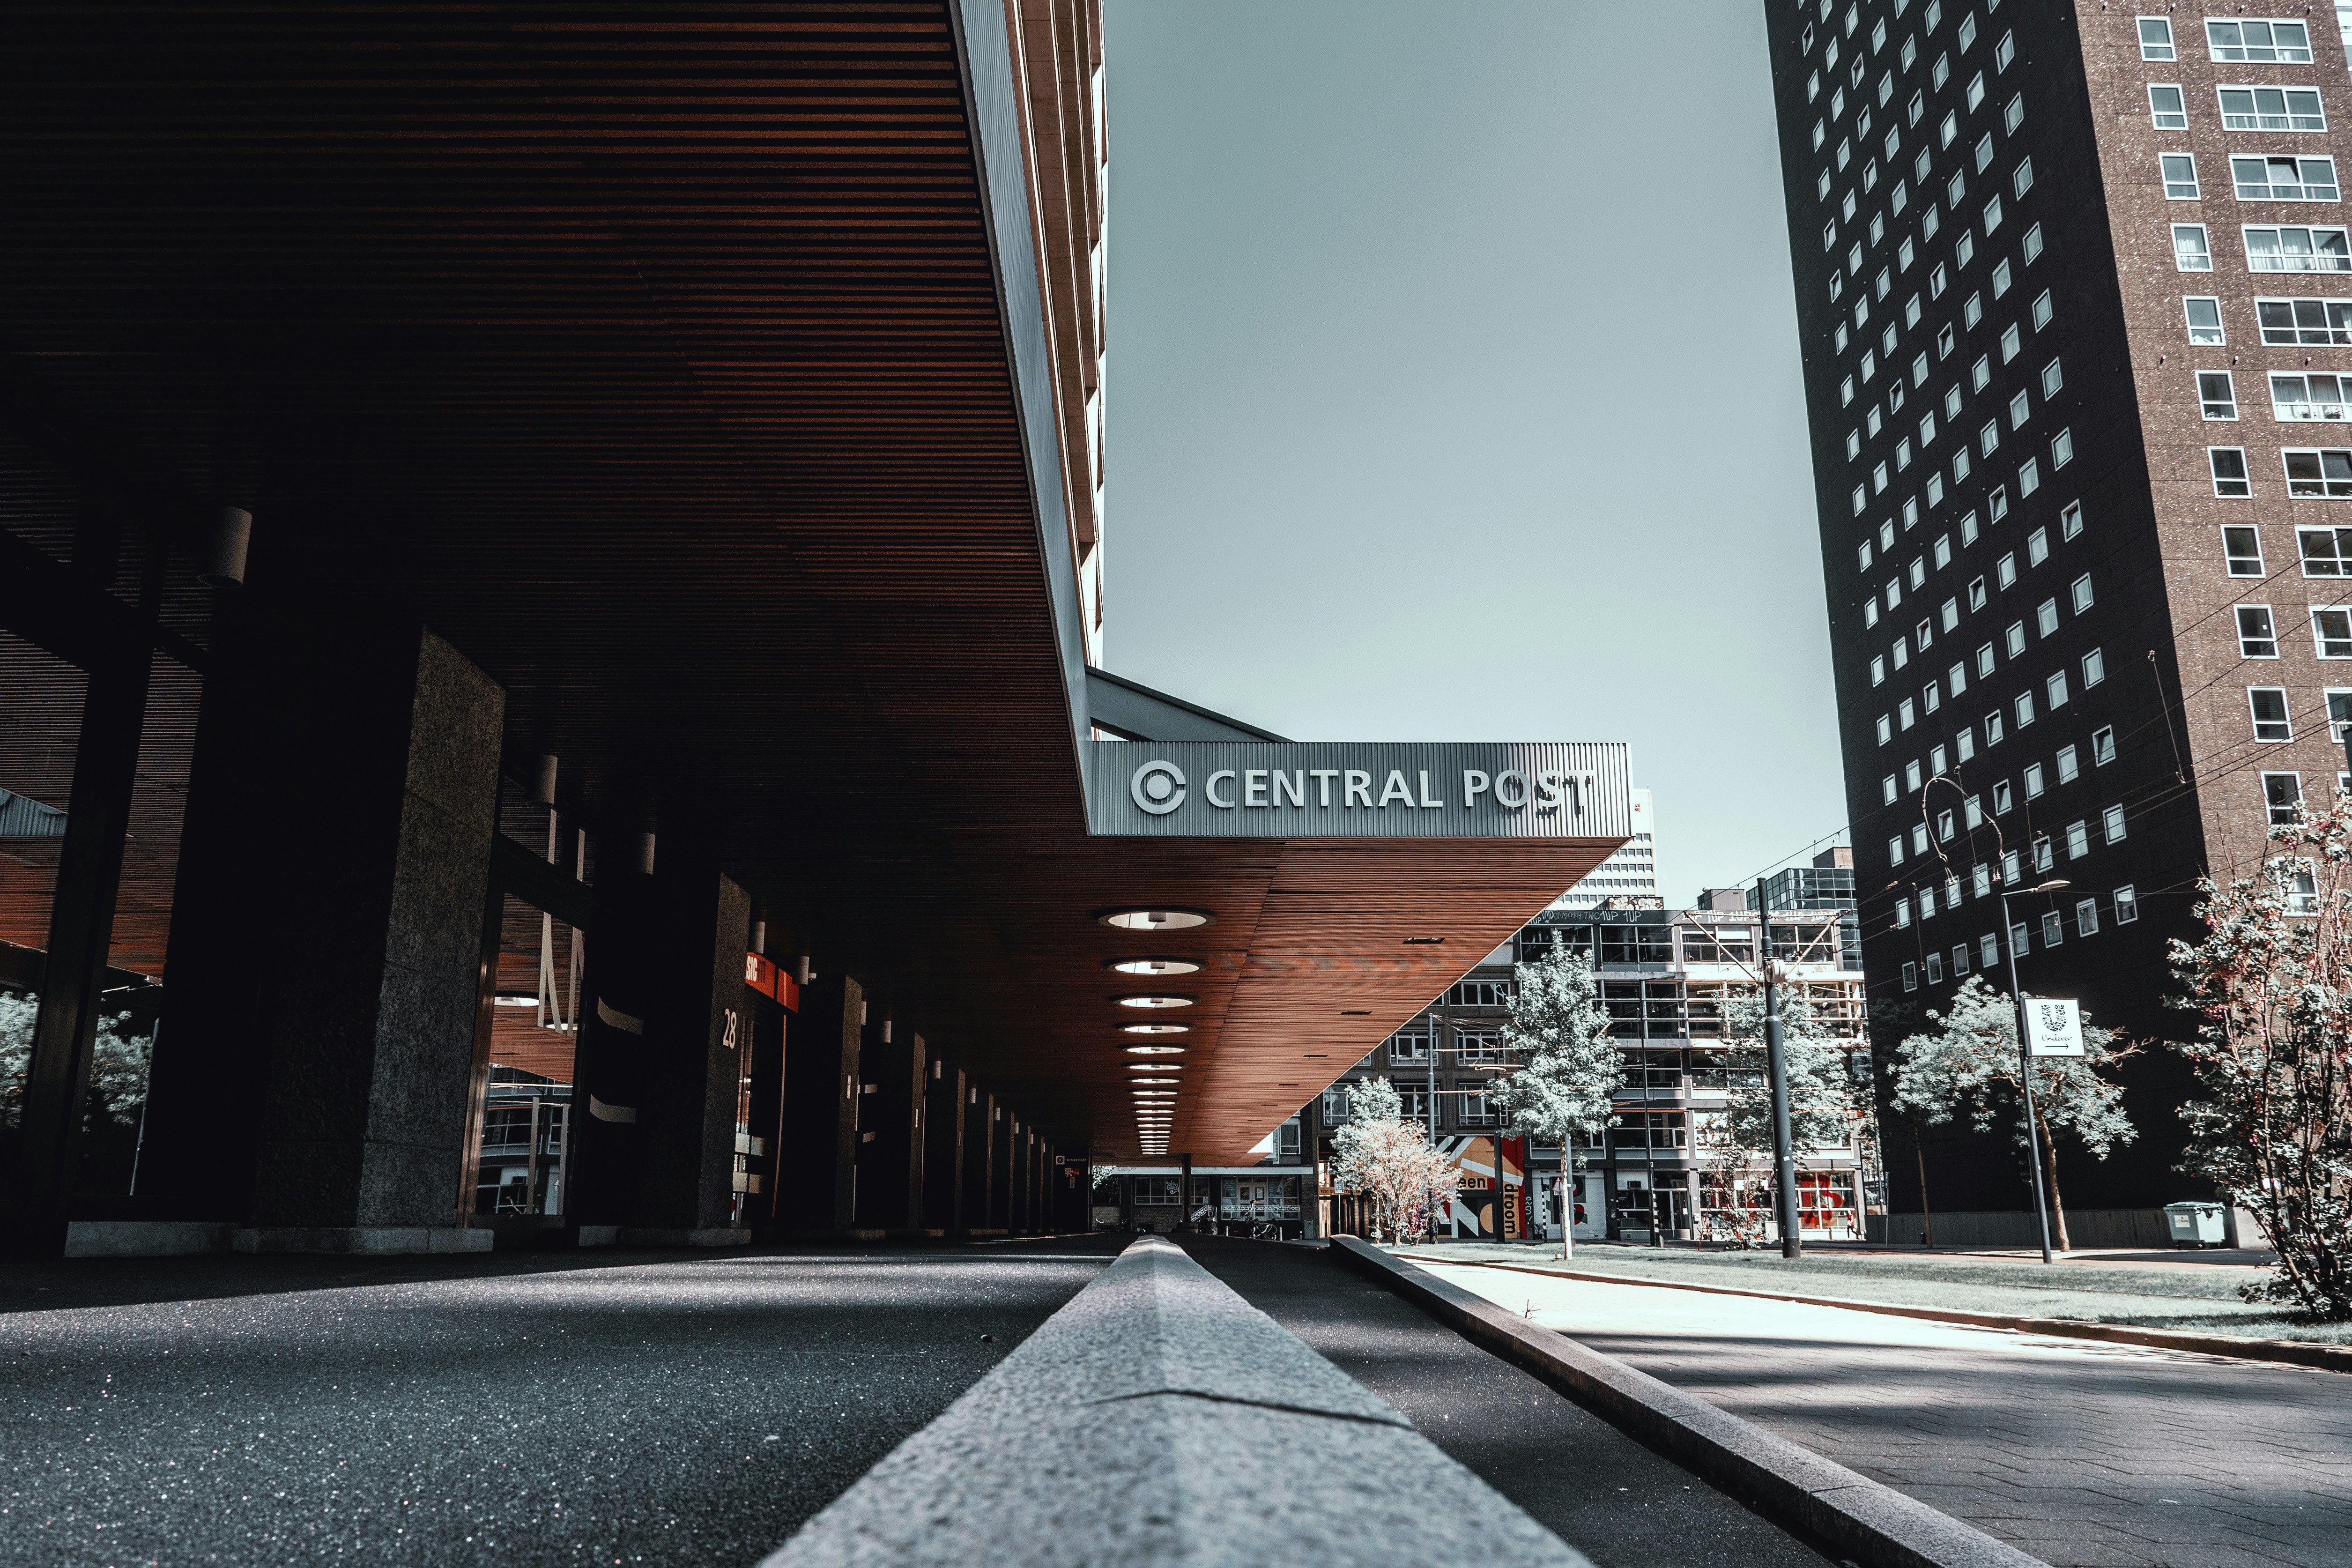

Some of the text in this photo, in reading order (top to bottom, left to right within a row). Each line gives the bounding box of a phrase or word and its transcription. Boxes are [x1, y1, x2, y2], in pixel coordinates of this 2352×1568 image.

[1206, 769, 1595, 808] CENTRAL POST
[1600, 910, 1641, 922] 1UP 1UP
[723, 1008, 737, 1049] 28
[1504, 1183, 1518, 1234] droom
